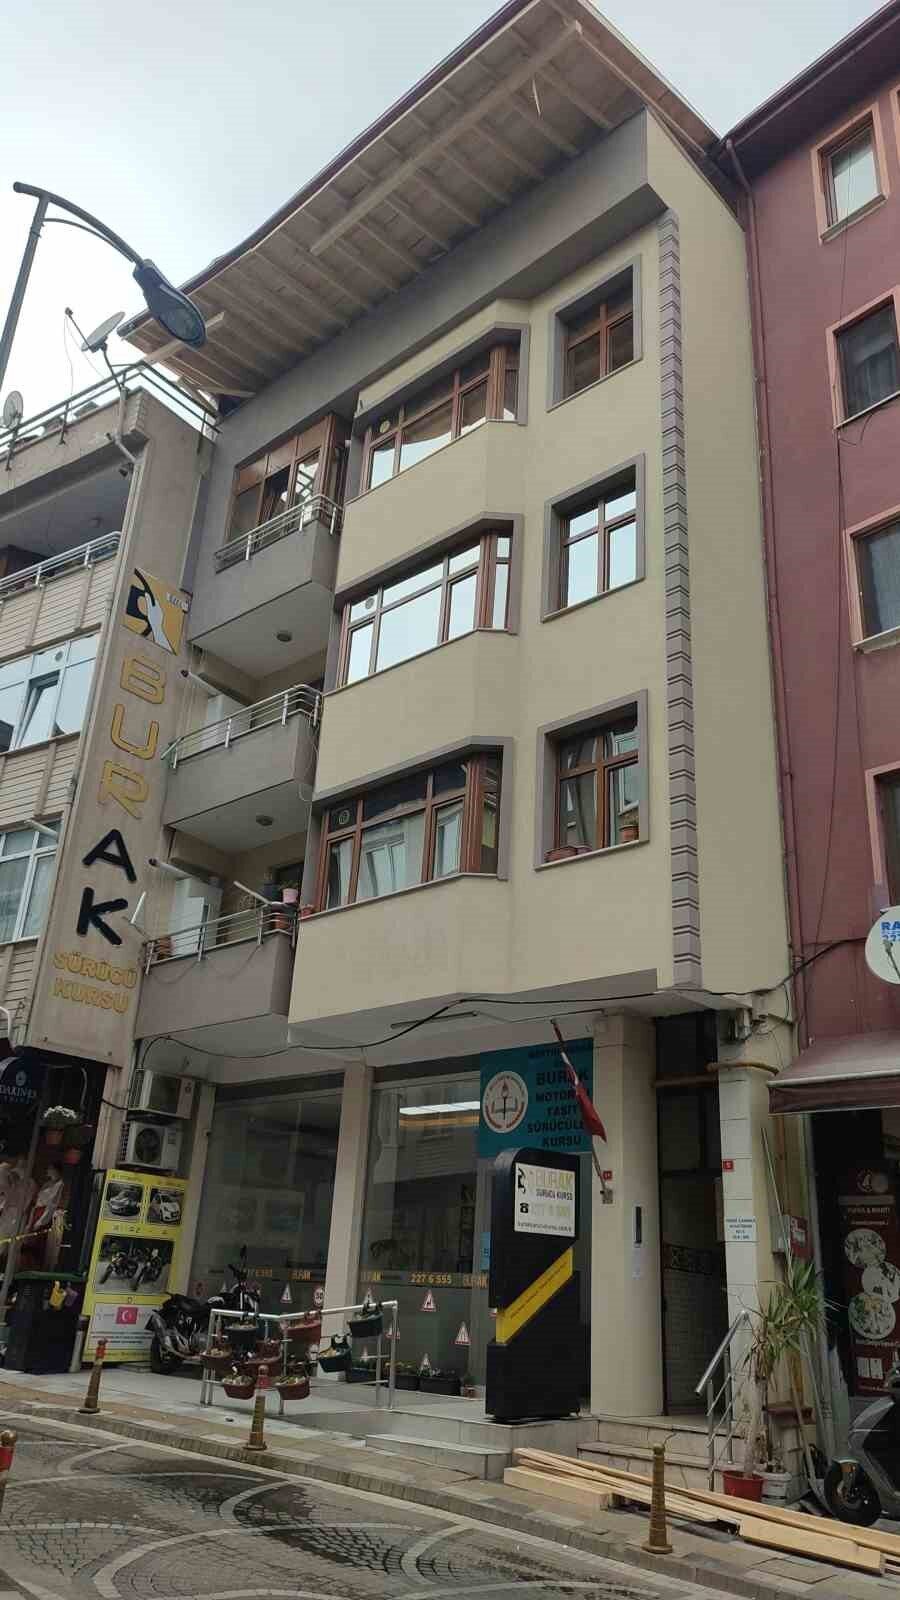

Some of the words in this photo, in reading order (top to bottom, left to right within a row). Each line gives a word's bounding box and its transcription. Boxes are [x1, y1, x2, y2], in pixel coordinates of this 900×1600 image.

[77, 654, 166, 946] BURAK
[54, 951, 137, 989] SÜRÜCÜ
[54, 976, 129, 1012] KURSU
